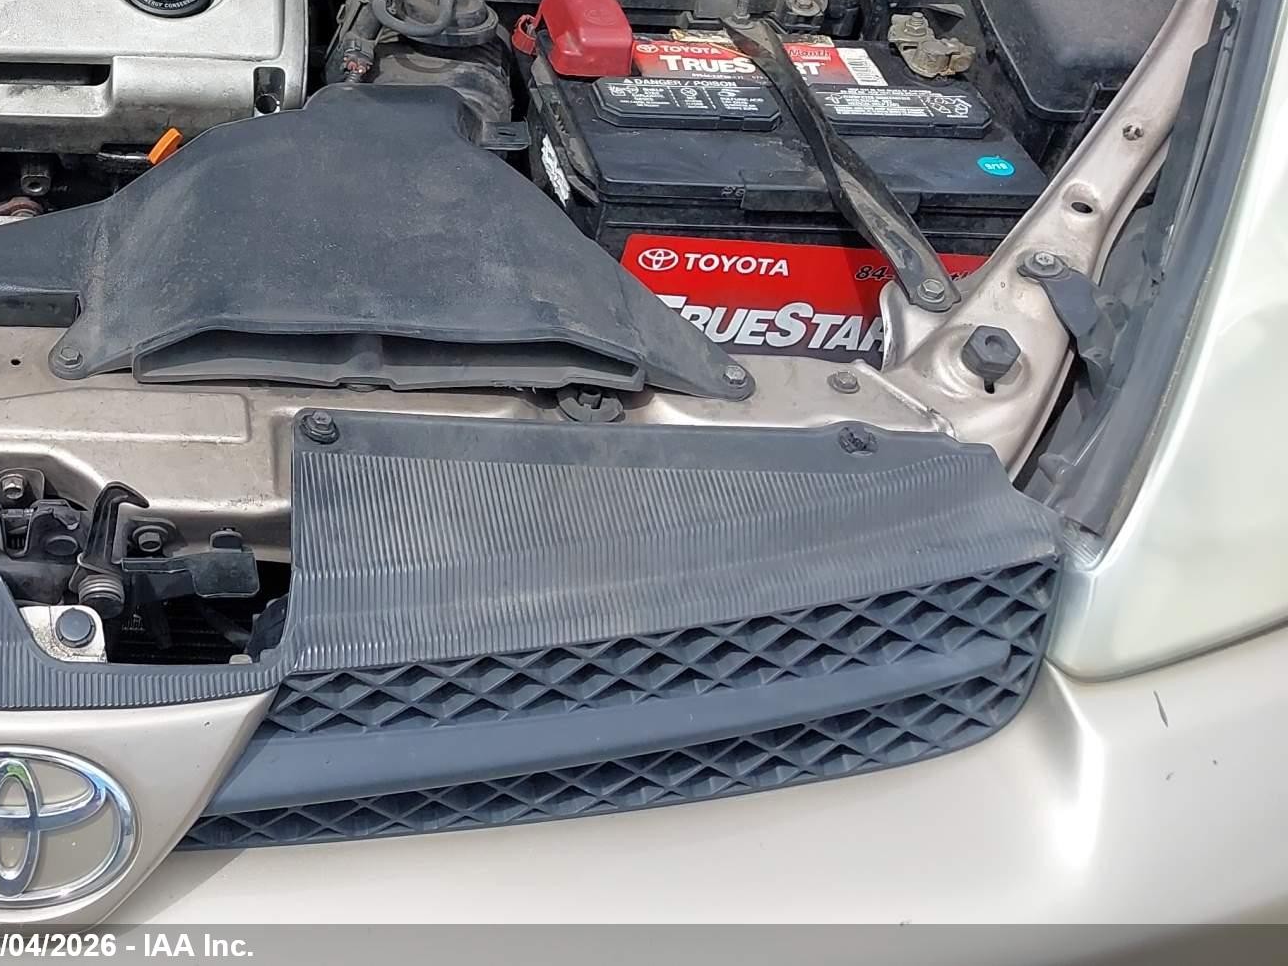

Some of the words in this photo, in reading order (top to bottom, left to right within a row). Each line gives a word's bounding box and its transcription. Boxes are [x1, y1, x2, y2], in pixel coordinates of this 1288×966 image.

[660, 44, 722, 55] TOYOTA
[633, 78, 682, 87] DANGER
[693, 80, 737, 88] POISON
[683, 252, 790, 277] TOYOTA
